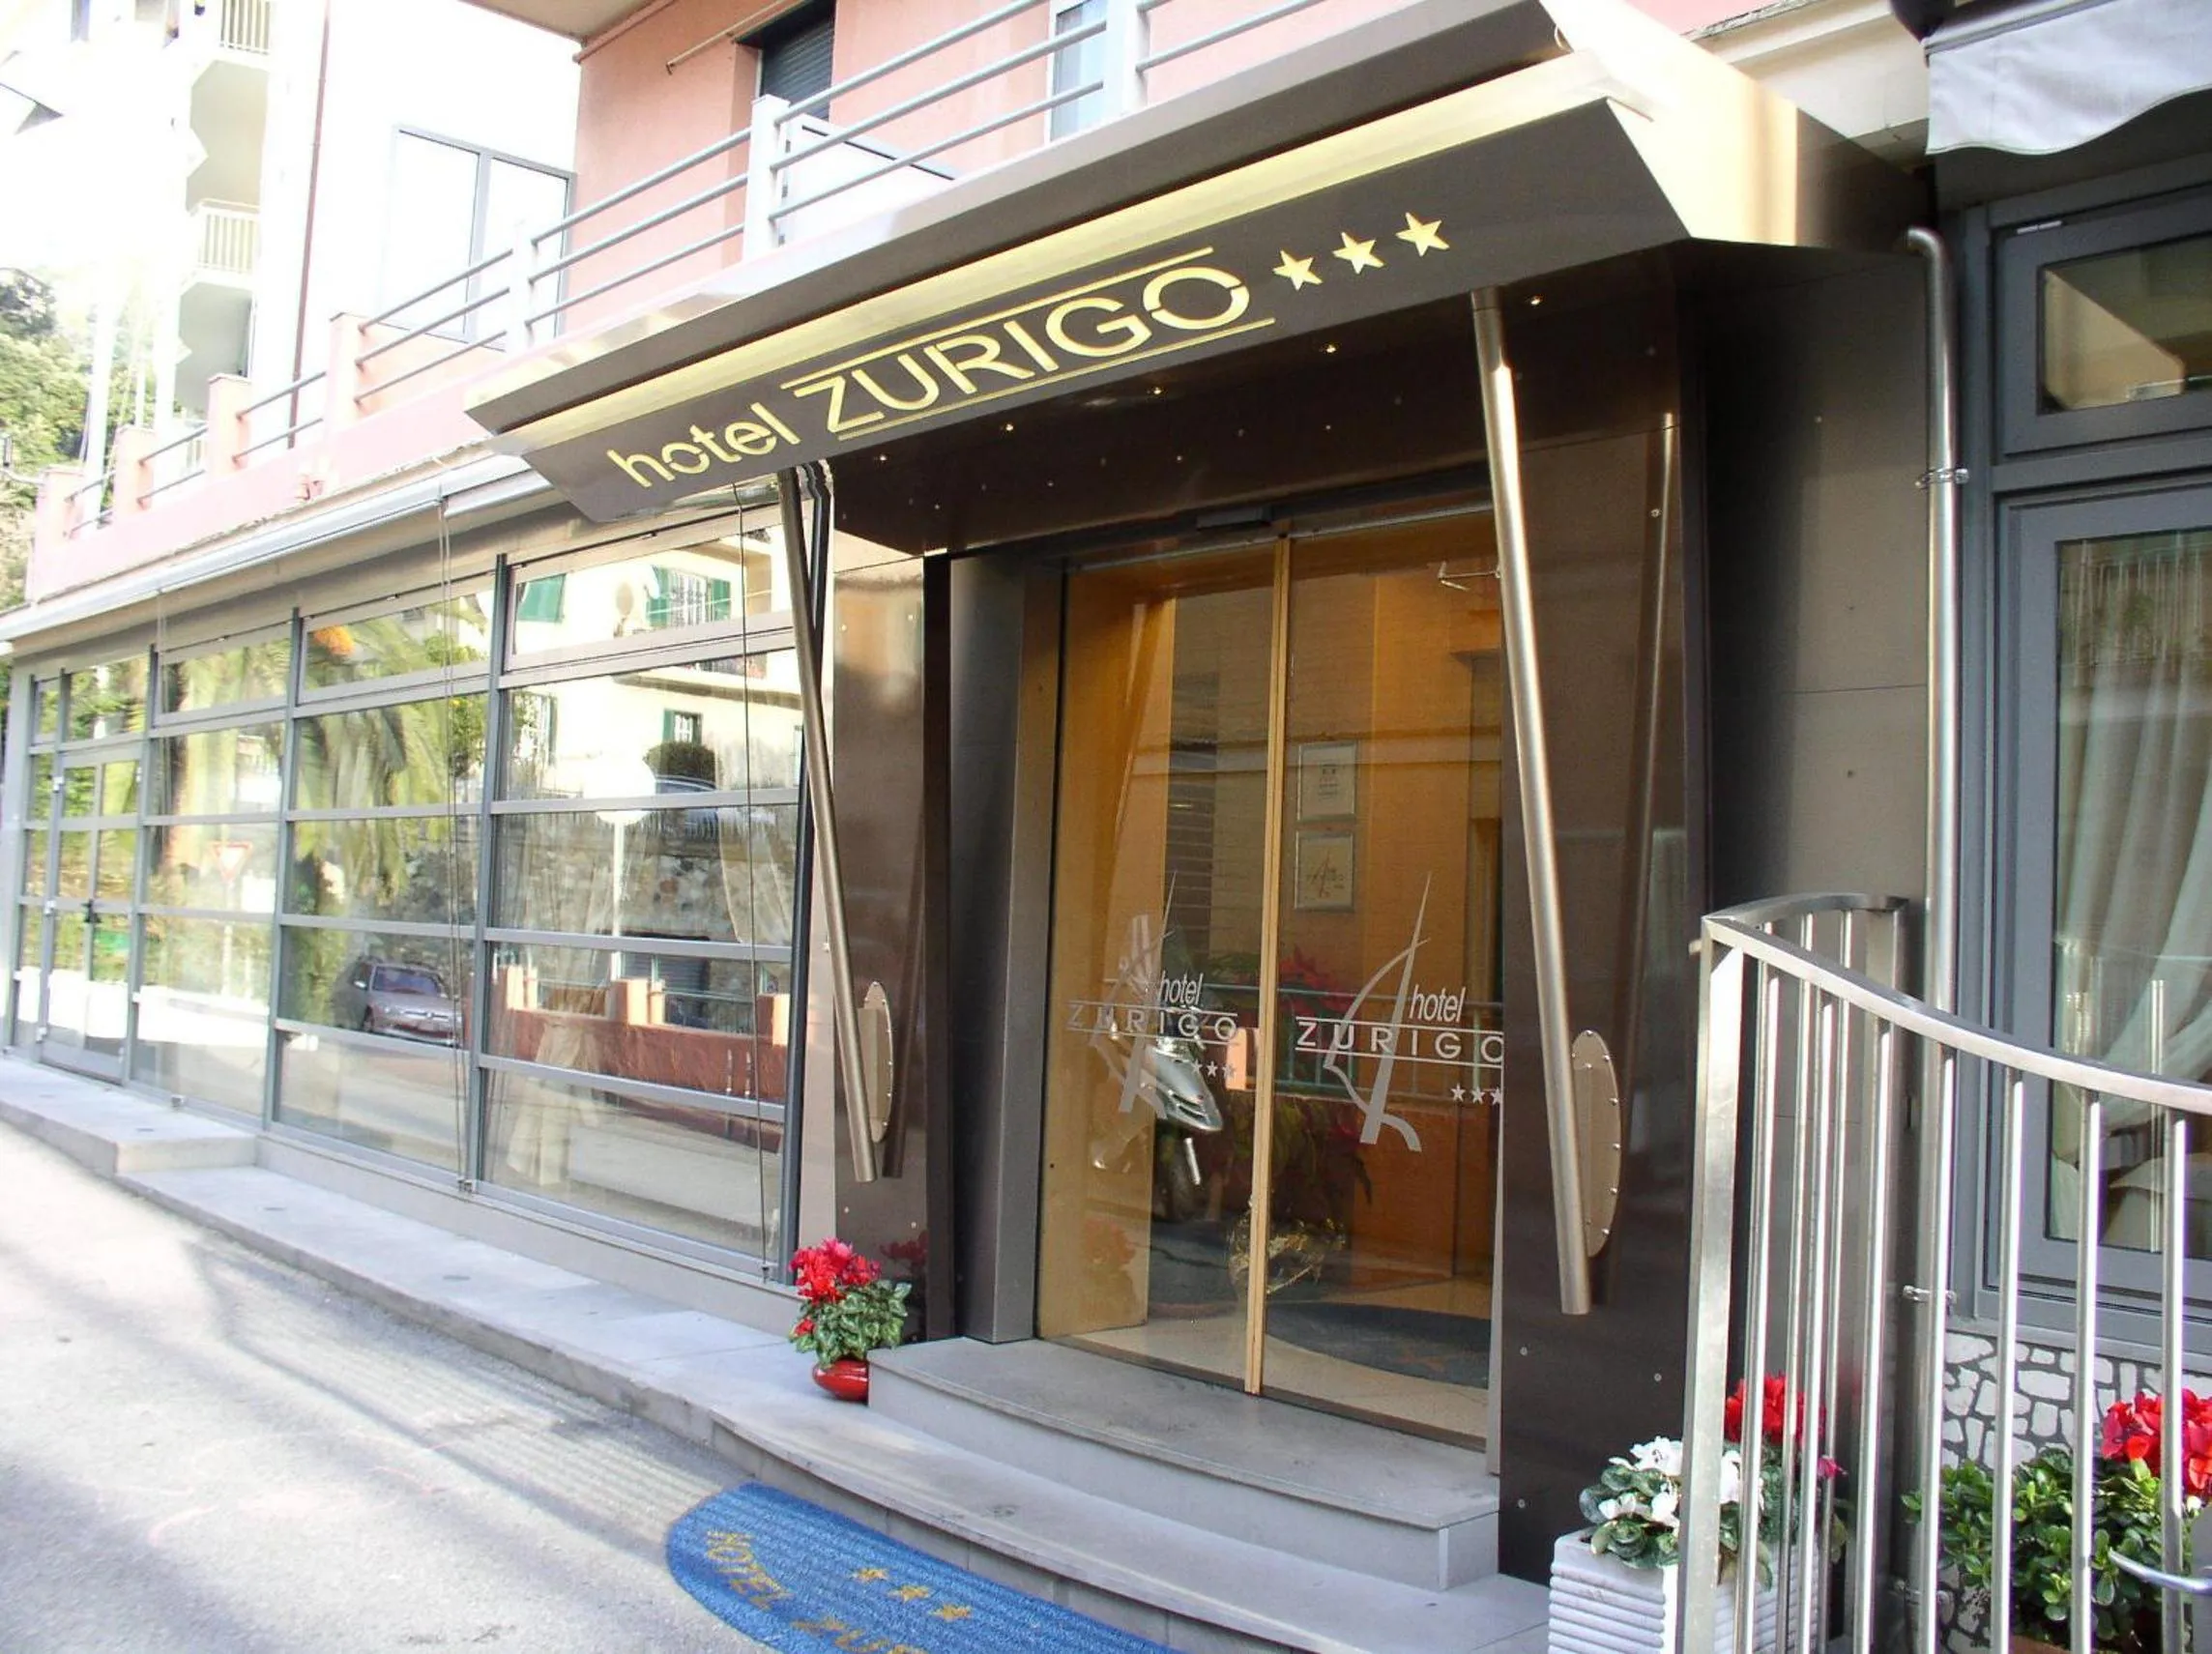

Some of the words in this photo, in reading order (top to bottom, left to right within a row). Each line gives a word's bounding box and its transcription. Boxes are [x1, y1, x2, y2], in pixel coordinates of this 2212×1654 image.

[606, 401, 800, 488] hotel
[795, 265, 1250, 434] ZURIGO
[1159, 970, 1204, 1005] hotel
[1409, 984, 1467, 1023] hotel
[1065, 1003, 1237, 1040] ZURIGO
[1296, 1021, 1504, 1063] ZURIGO
